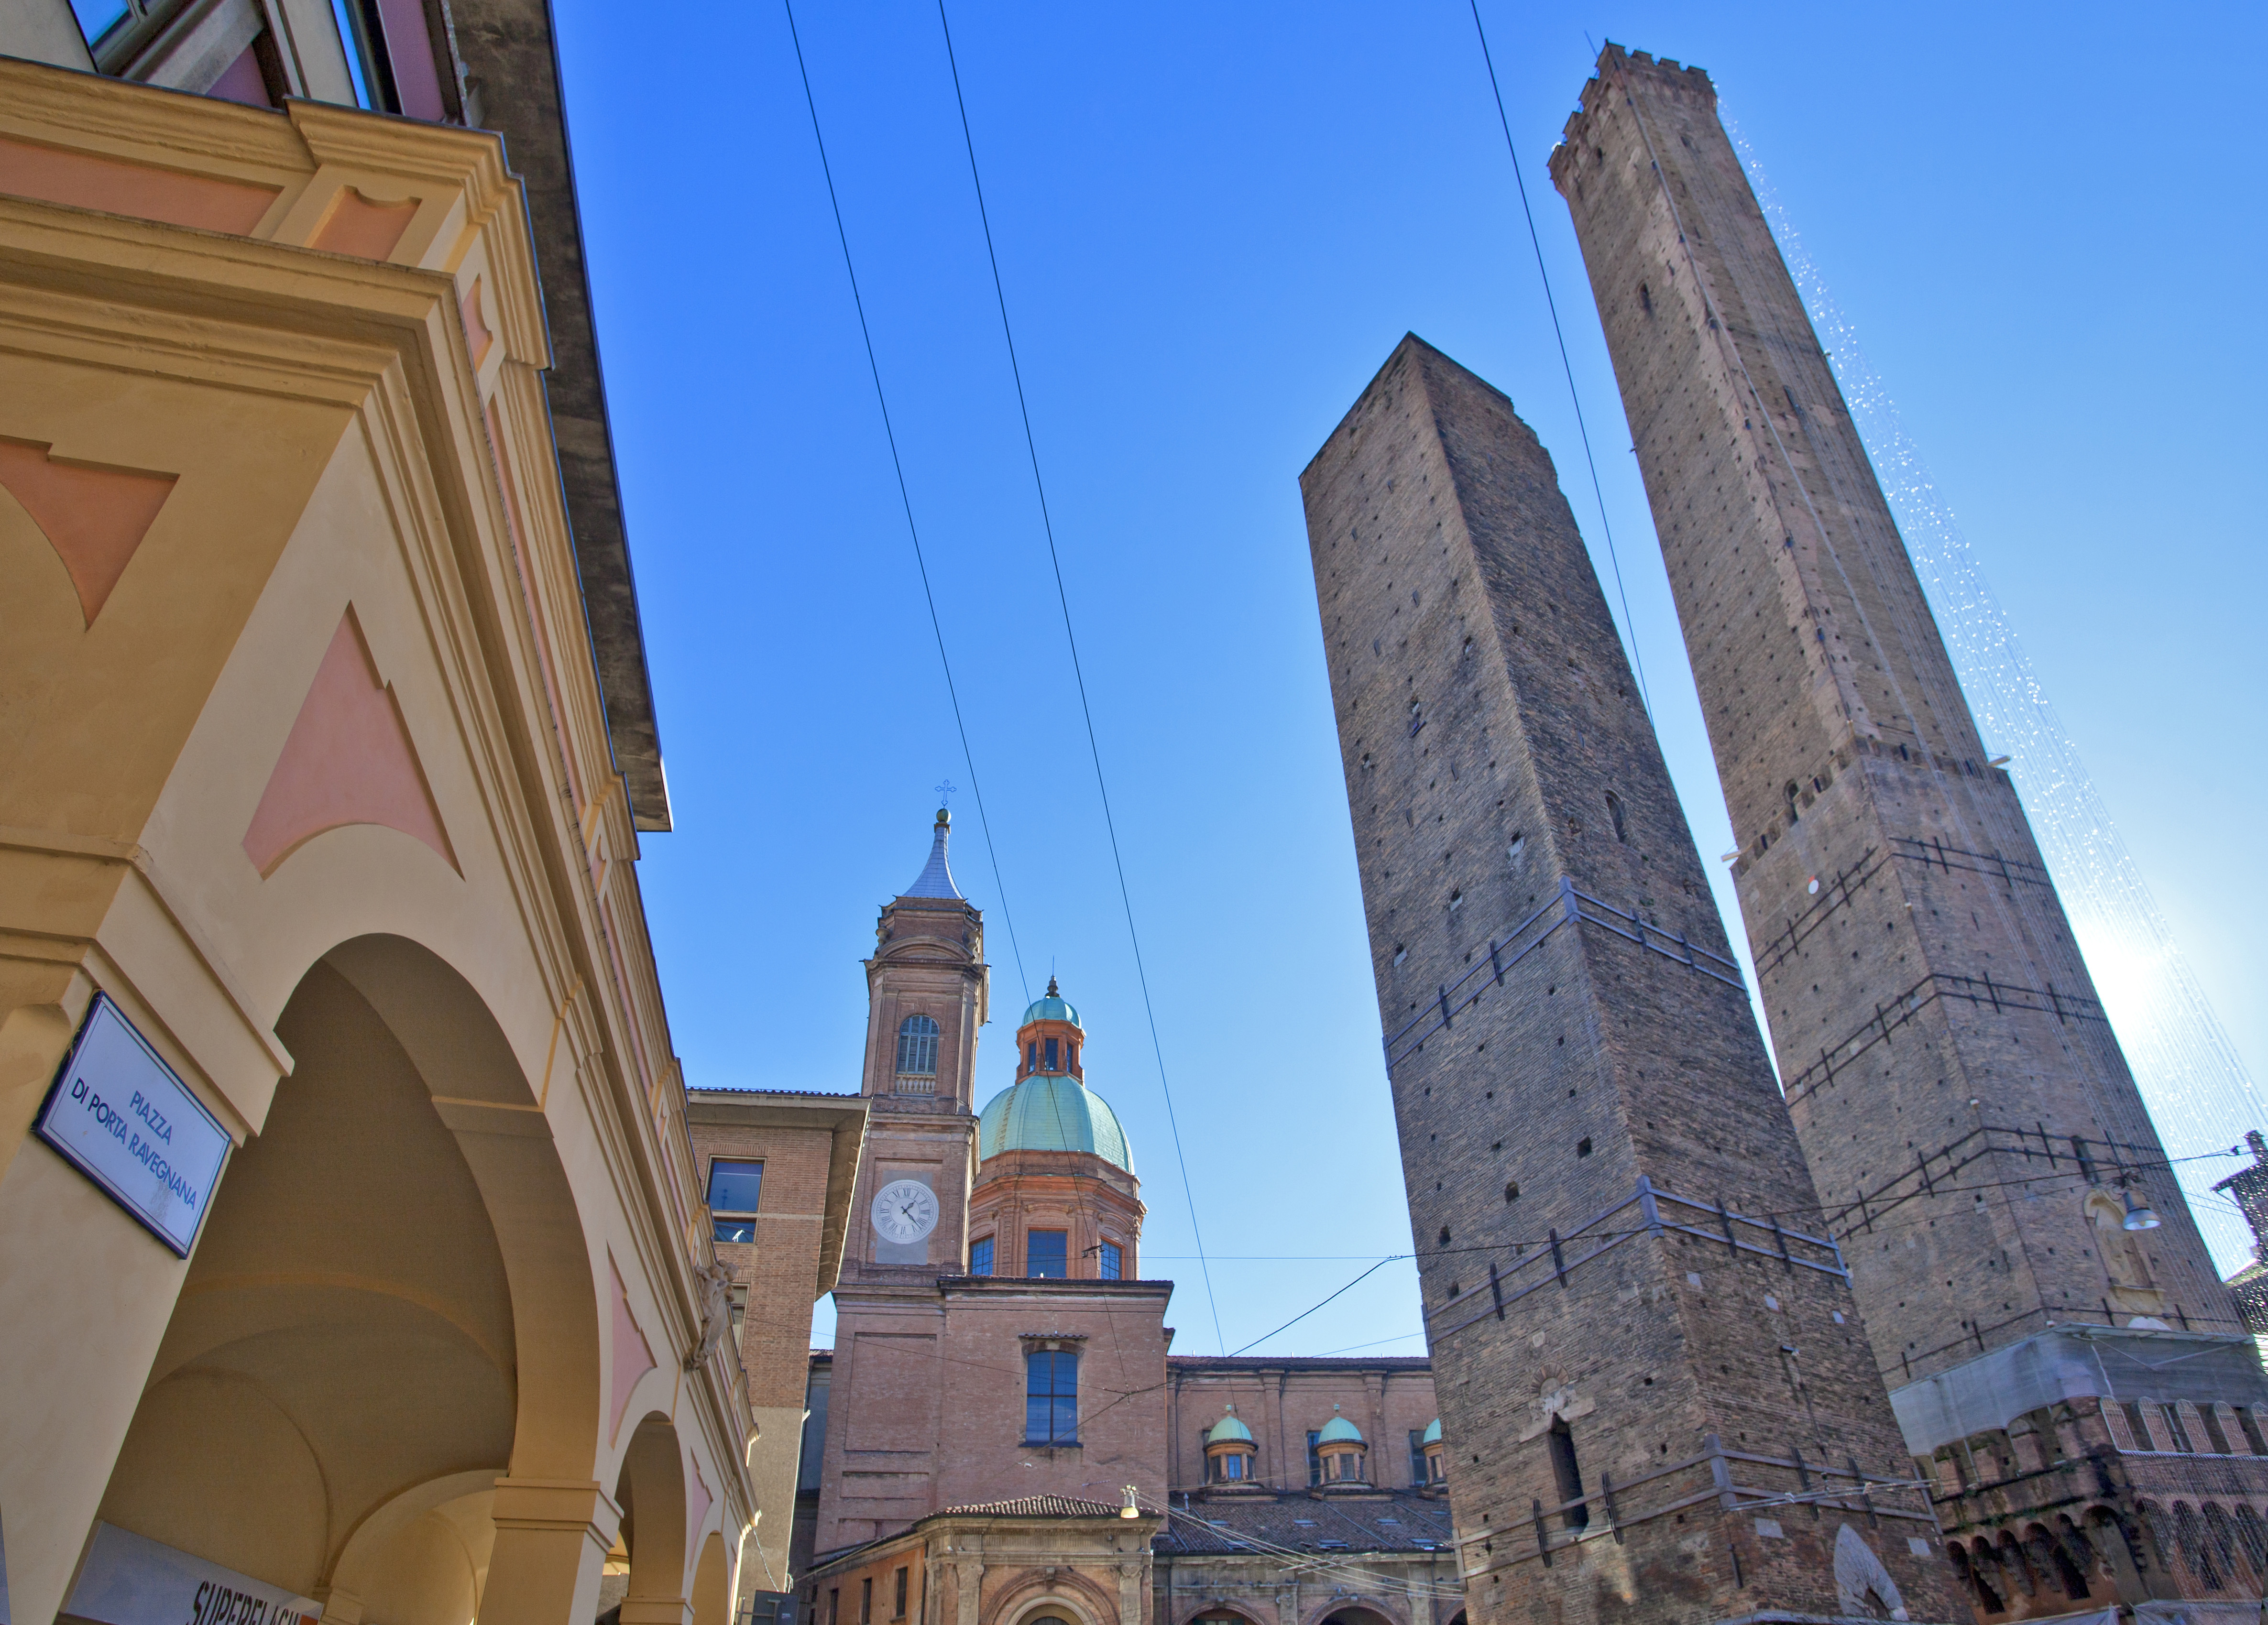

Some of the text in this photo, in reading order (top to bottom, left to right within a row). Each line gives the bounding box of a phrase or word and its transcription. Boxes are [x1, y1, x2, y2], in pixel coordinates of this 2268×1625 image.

[71, 1077, 197, 1210] DI PORTA RAVEGNANA
[130, 1090, 173, 1145] PIAZZA
